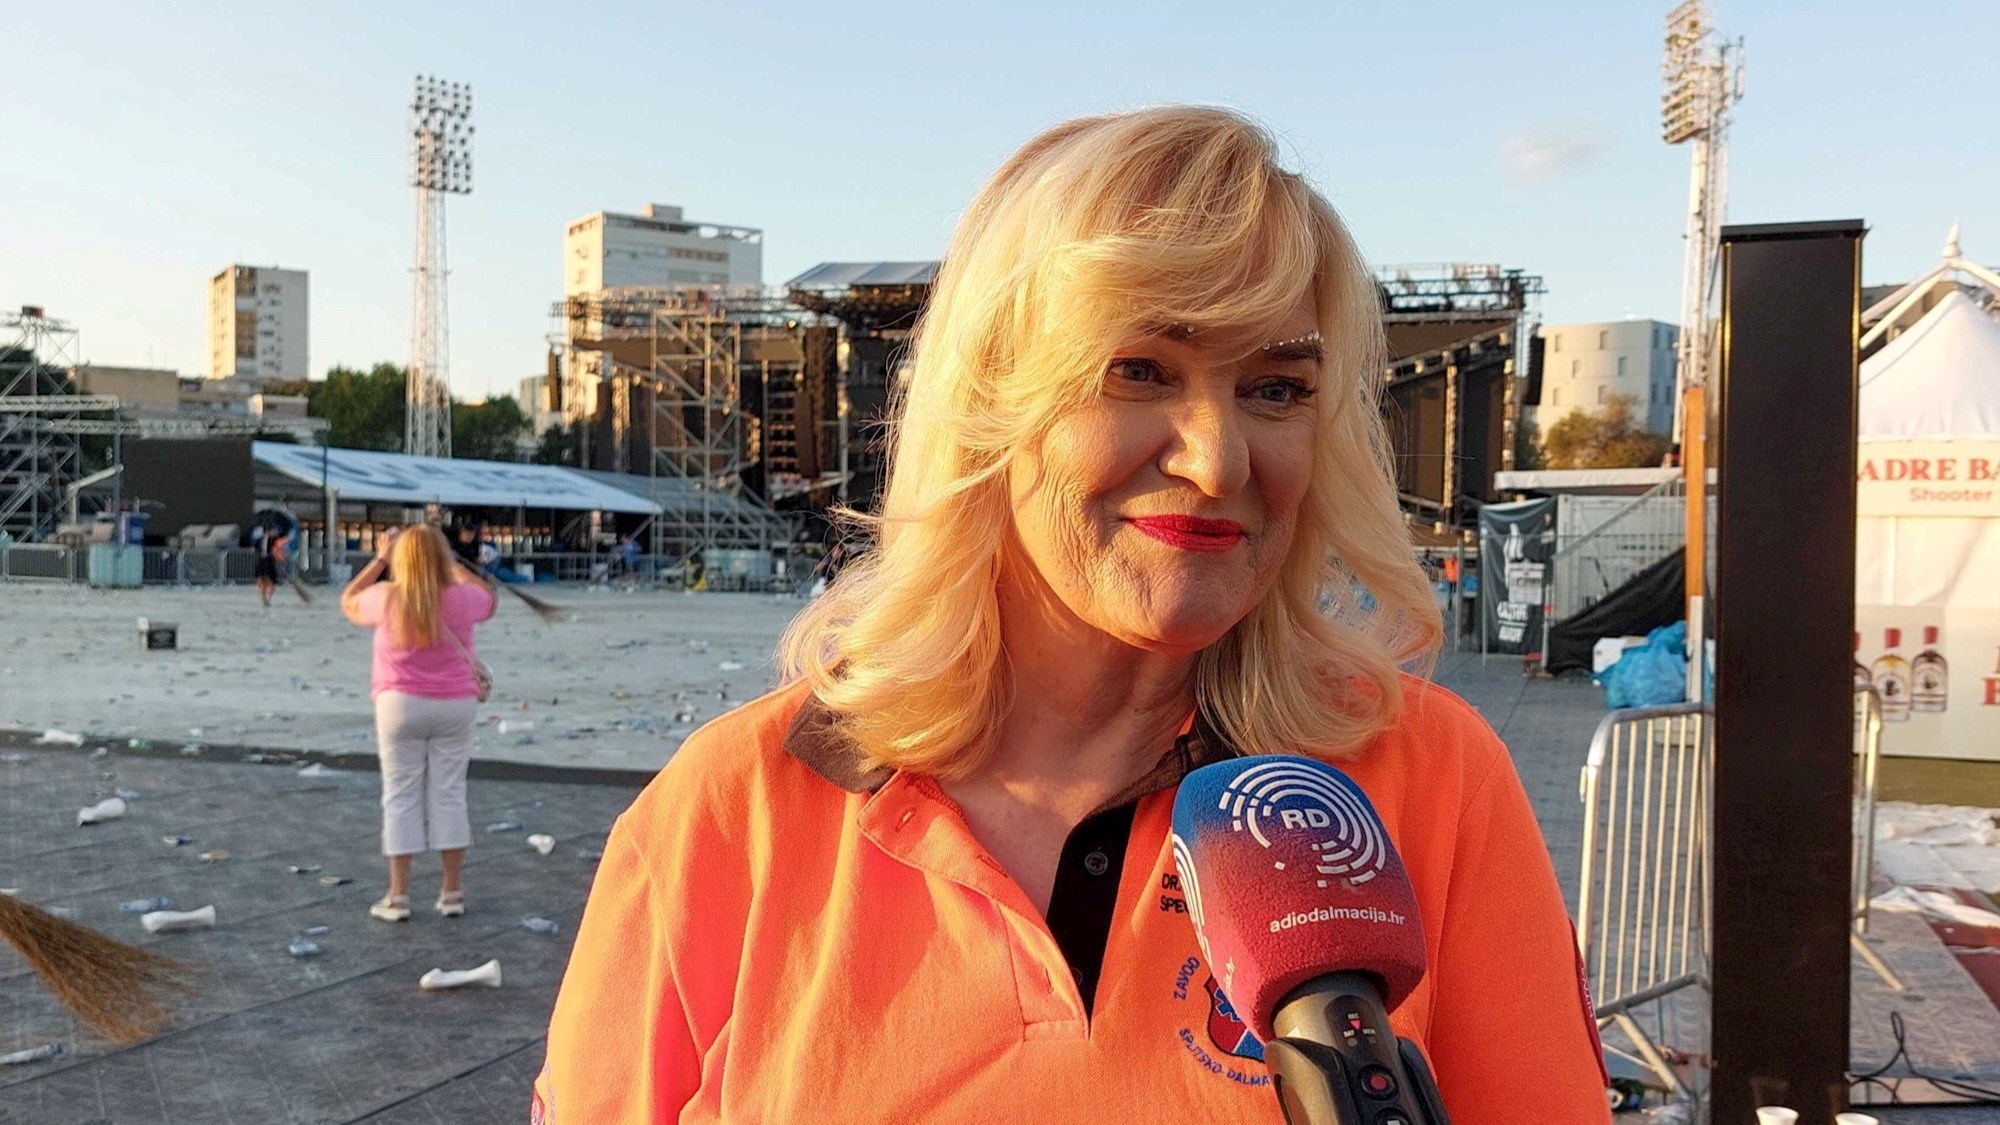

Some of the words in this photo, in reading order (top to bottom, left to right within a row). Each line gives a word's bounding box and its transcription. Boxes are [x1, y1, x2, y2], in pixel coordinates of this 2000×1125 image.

[1908, 487, 1992, 502] Shooter
[1280, 808, 1331, 830] RD
[1269, 905, 1406, 933] adiodalmacija.hr
